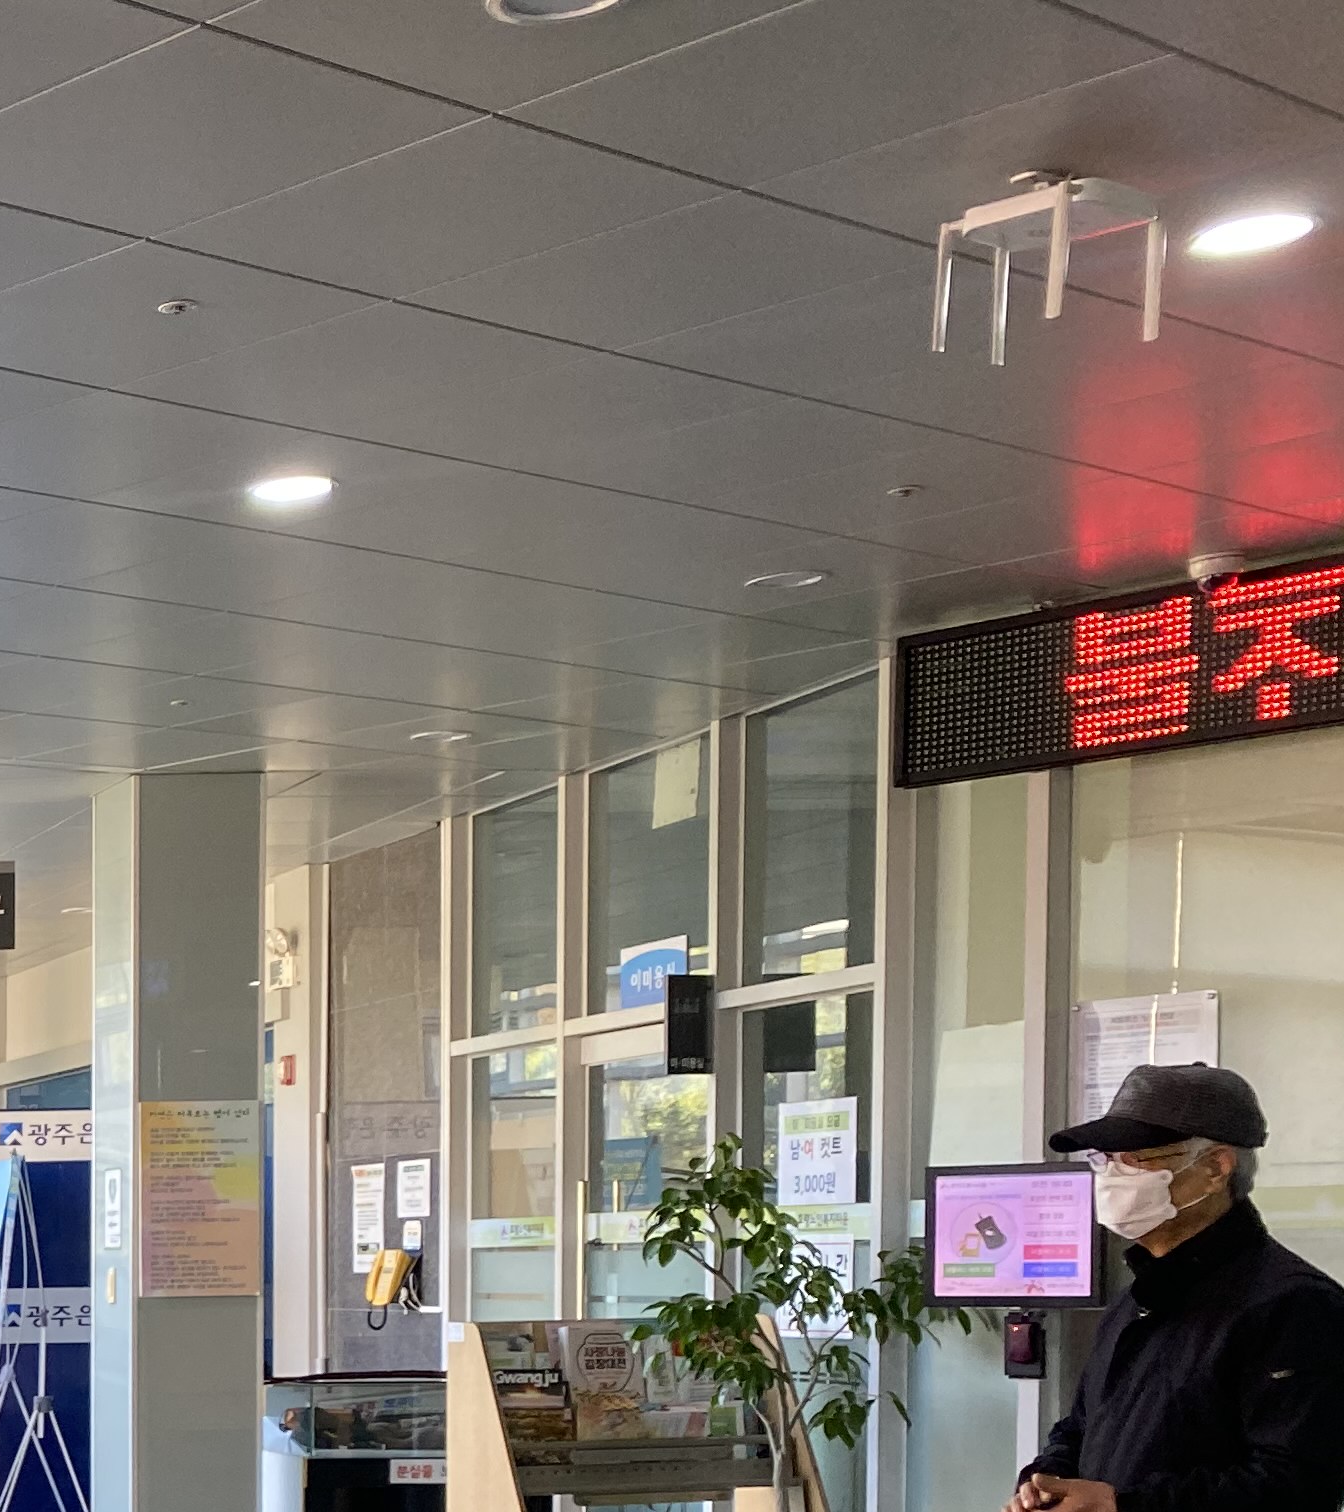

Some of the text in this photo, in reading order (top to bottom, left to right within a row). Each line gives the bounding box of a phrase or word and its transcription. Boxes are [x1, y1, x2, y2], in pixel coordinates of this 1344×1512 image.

[27, 1122, 92, 1146] 광주은
[794, 1172, 836, 1195] 3,000원
[26, 1304, 91, 1328] 광주은
[493, 1369, 559, 1388] Gwangju
